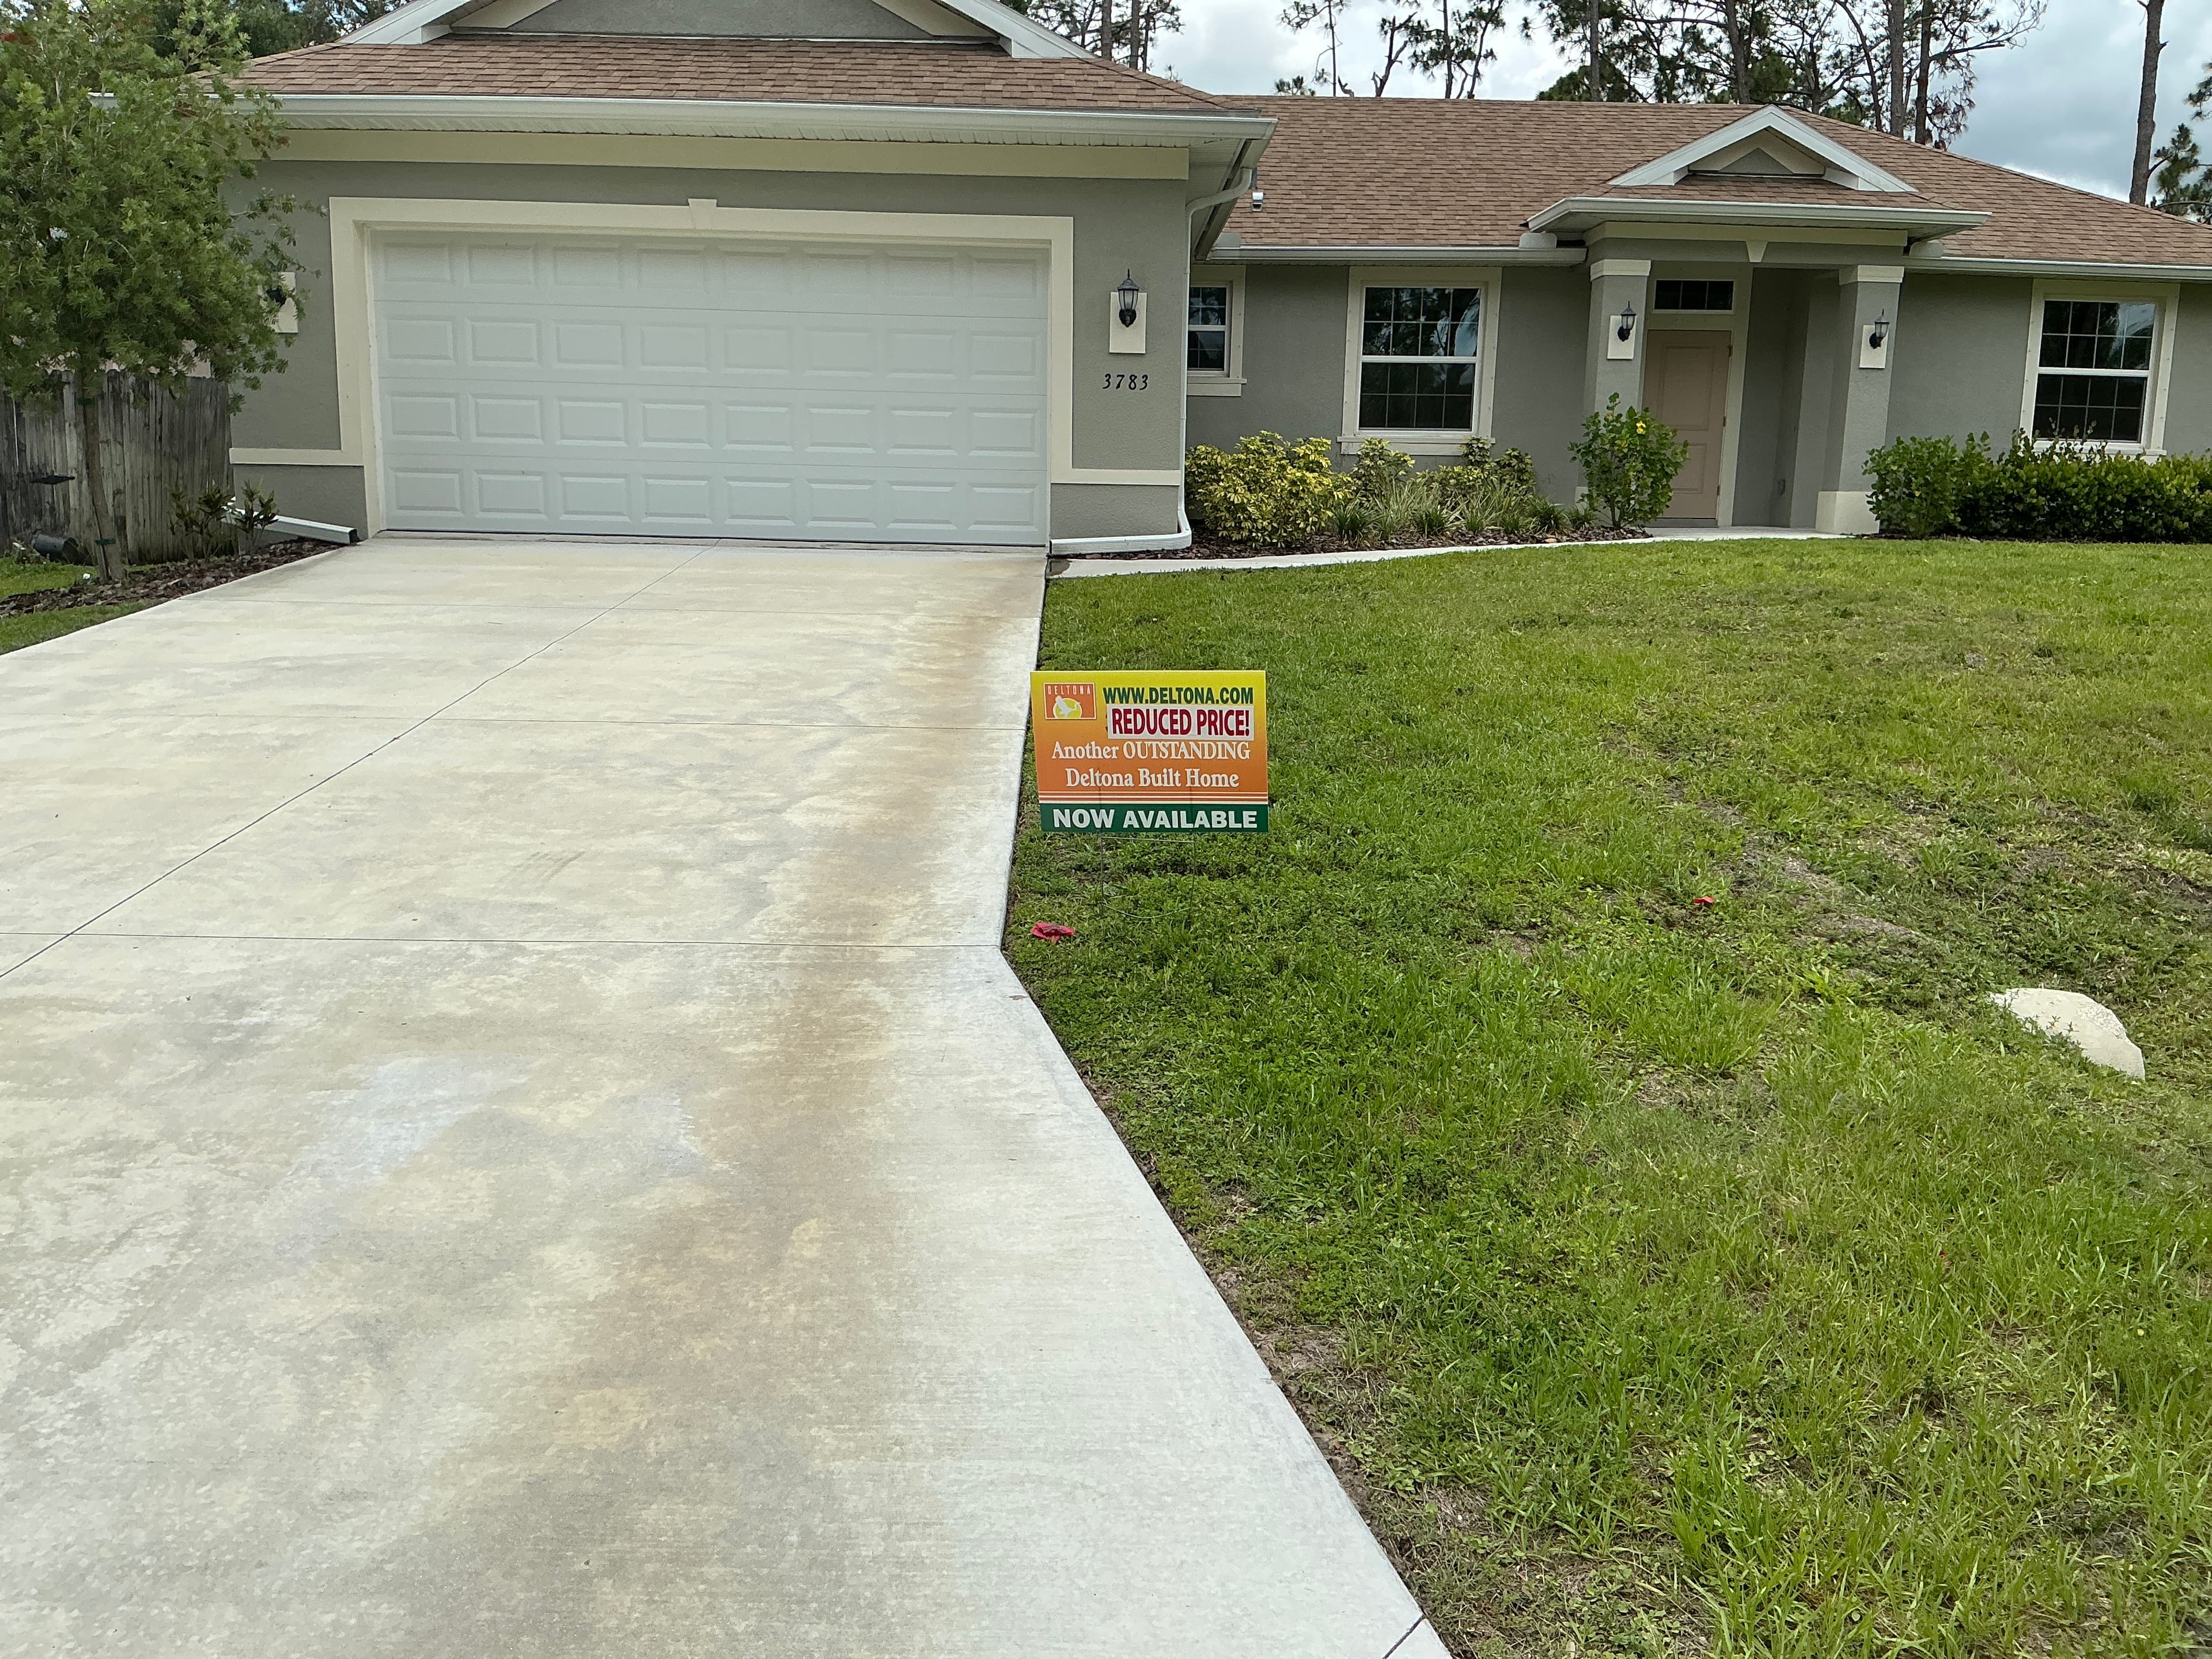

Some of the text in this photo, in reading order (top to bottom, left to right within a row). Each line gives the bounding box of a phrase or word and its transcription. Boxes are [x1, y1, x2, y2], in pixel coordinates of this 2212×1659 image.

[1103, 373, 1148, 390] 3783
[1047, 685, 1091, 695] DELTONA
[1103, 687, 1253, 704] WWW.DELTONA.COM
[1112, 709, 1250, 737] REDUCED PRICE!
[1052, 741, 1251, 759] Another OUTSTANDING
[1066, 768, 1240, 787] Deltona Built Home
[1053, 809, 1257, 828] NOW AVAILABLE
